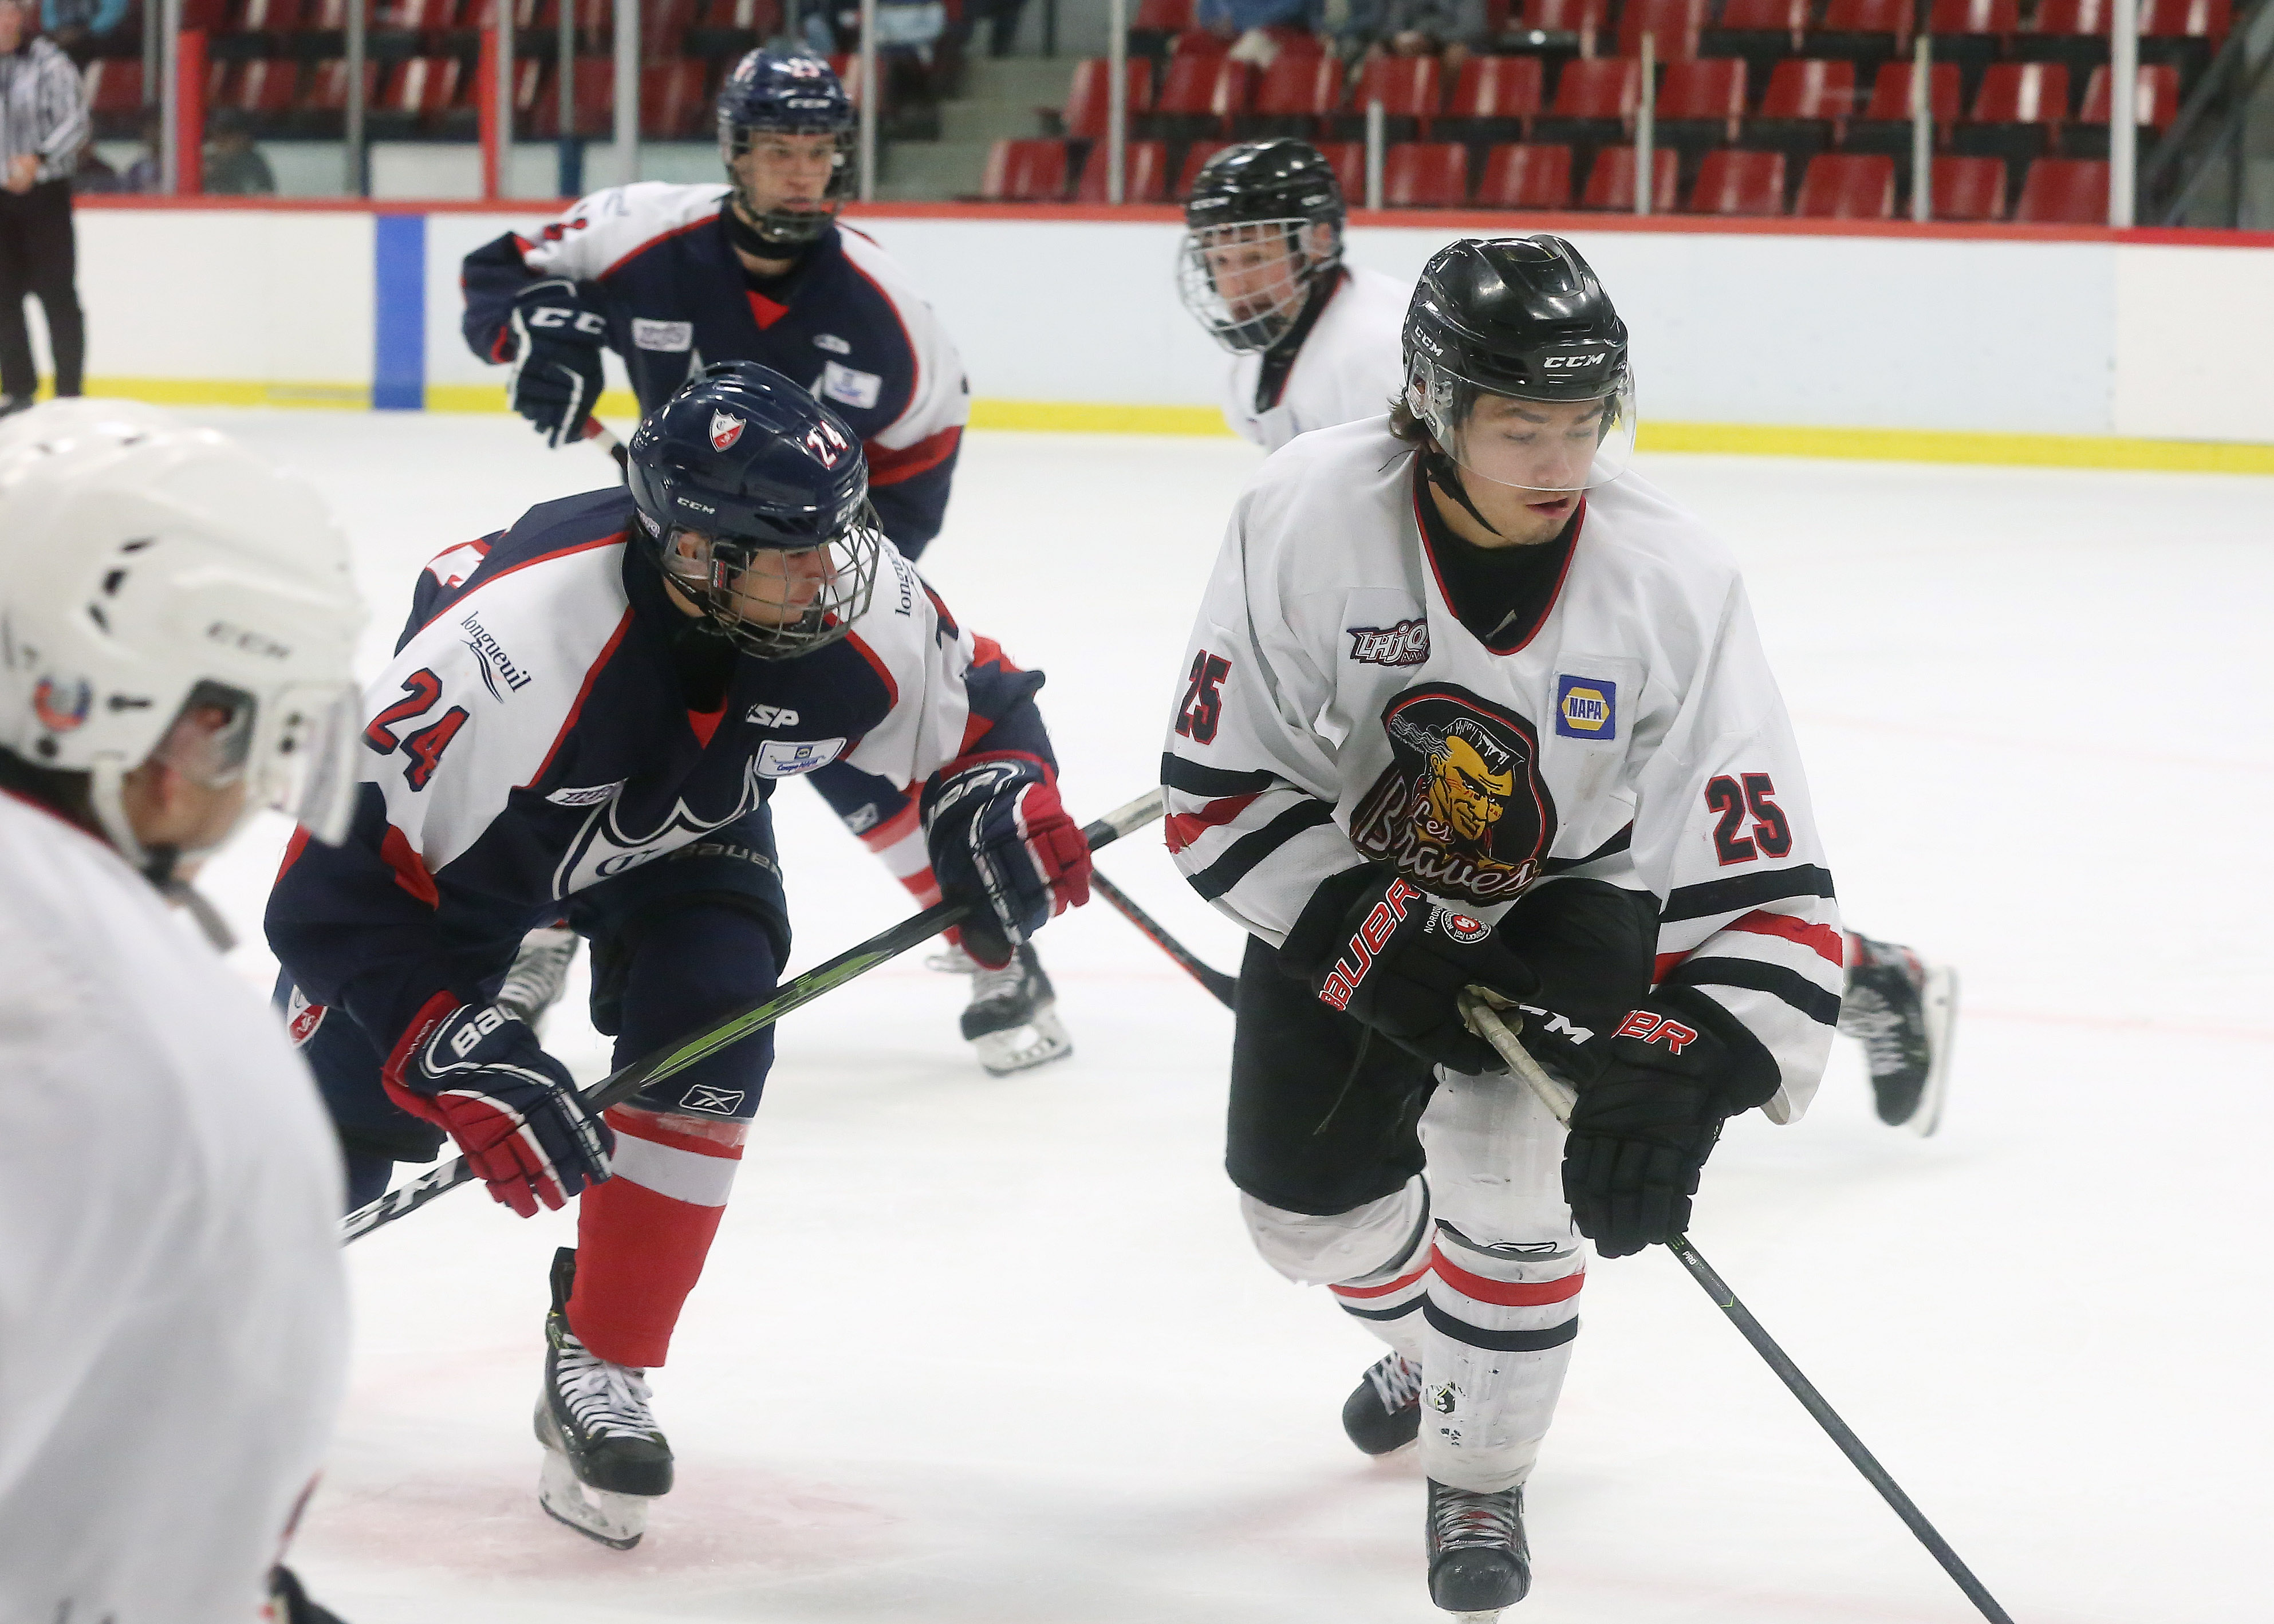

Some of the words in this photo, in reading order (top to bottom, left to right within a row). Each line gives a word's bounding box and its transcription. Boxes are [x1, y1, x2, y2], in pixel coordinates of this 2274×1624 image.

[1414, 325, 1445, 358] CCM
[1543, 352, 1606, 368] CCM
[805, 420, 849, 468] 24
[677, 496, 715, 515] CCM
[460, 610, 532, 693] longueuil
[1175, 649, 1232, 745] 25
[1568, 697, 1602, 720] NAPA
[360, 667, 470, 792] 24
[1356, 775, 1532, 895] Braves
[1704, 772, 1793, 866] 25
[1682, 1251, 1697, 1266] PRO
